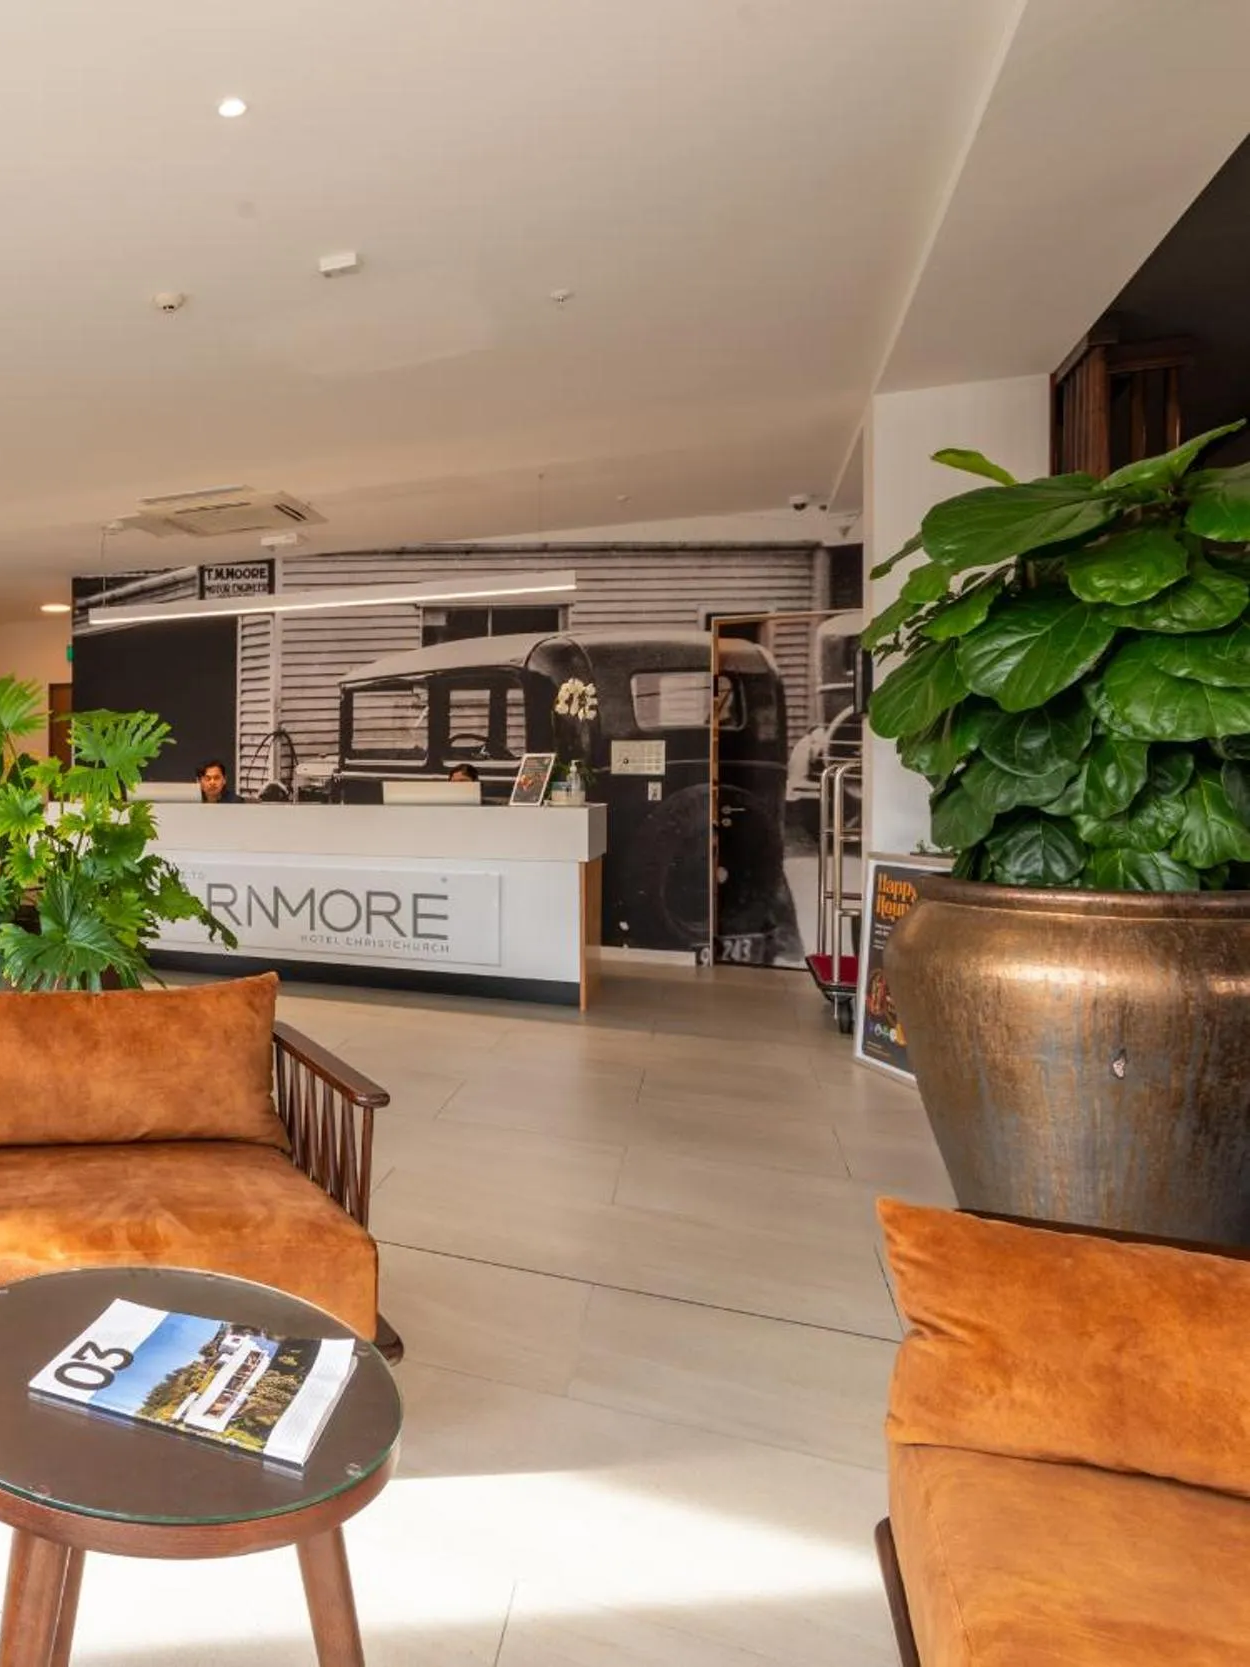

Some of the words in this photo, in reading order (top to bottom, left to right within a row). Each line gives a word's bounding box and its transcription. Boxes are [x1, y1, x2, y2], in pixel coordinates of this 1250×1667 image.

[877, 872, 918, 903] Happy
[206, 882, 449, 941] RNMORE
[300, 934, 340, 945] HOTEL
[345, 936, 450, 953] CHRISTCHURCH
[53, 1340, 135, 1391] 03
